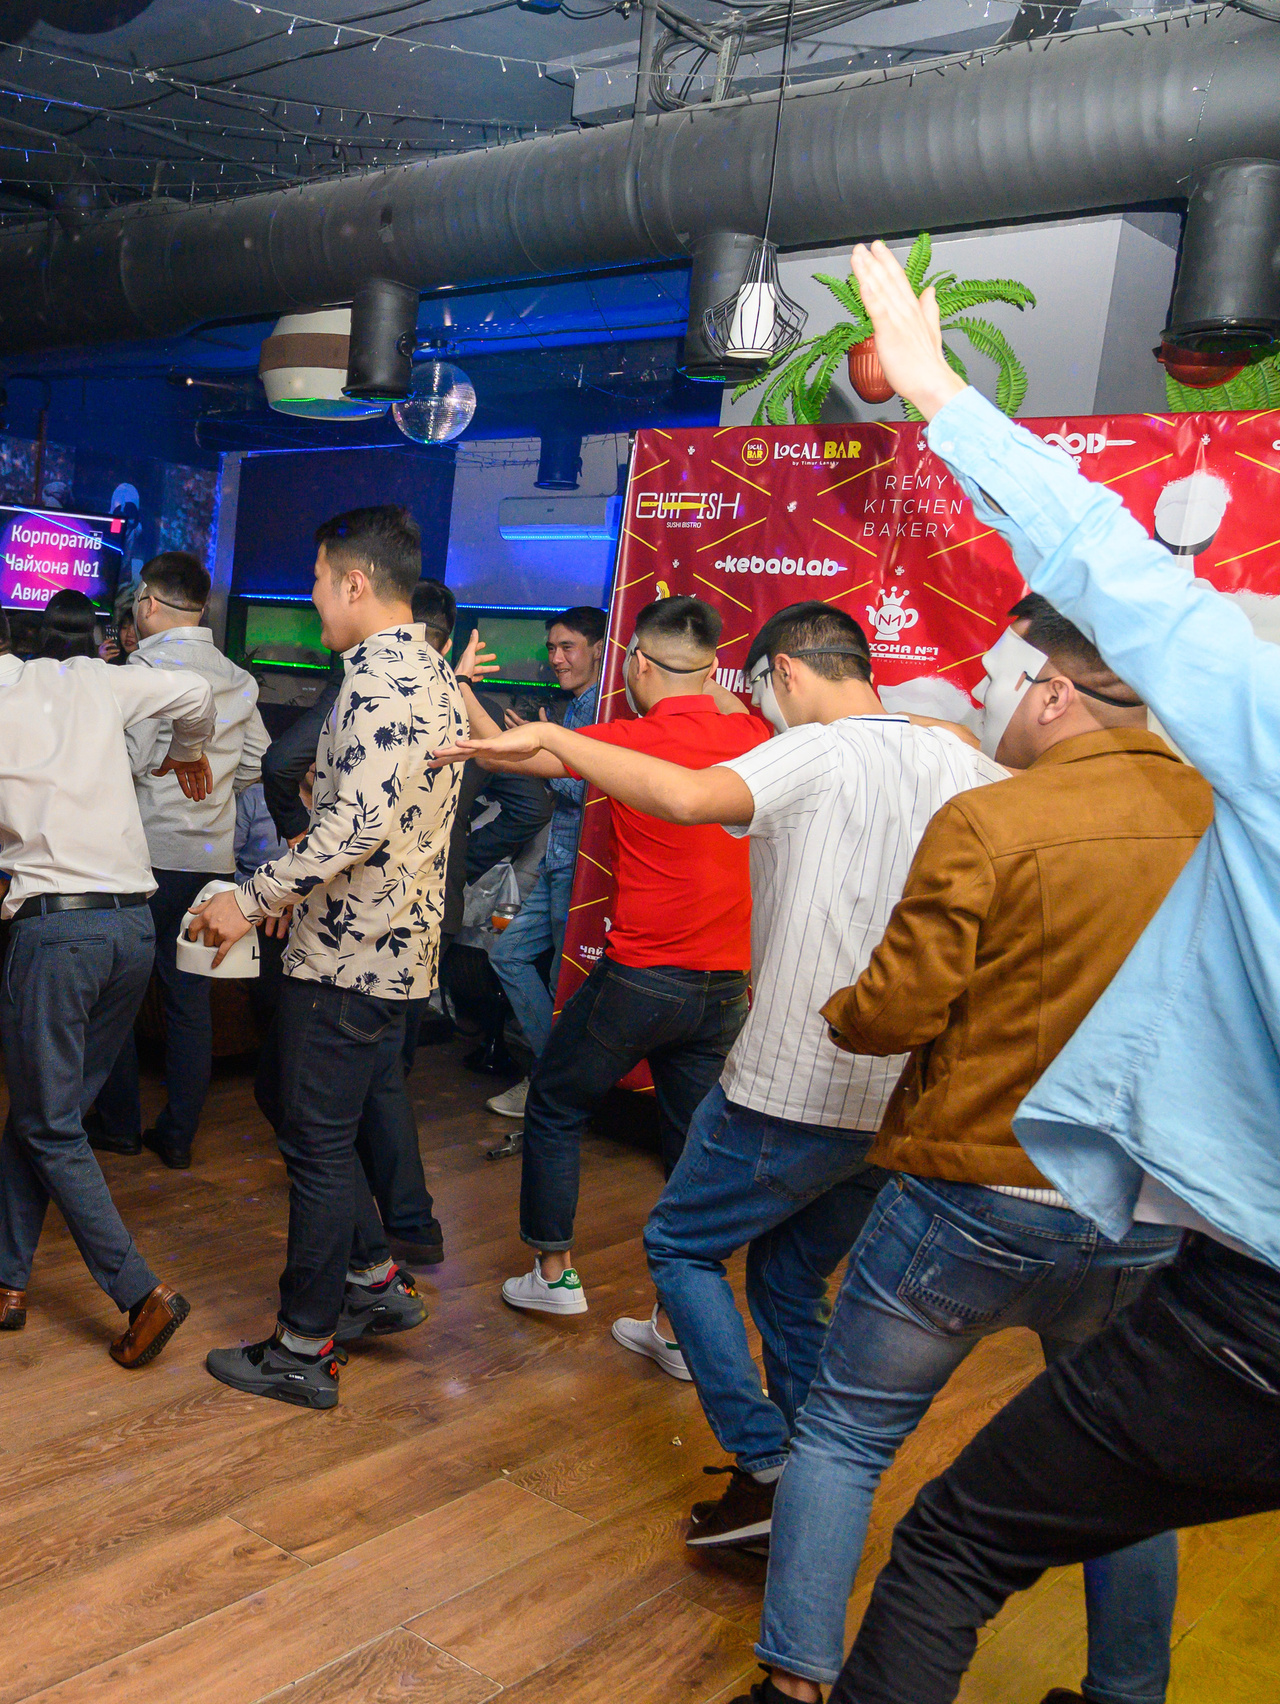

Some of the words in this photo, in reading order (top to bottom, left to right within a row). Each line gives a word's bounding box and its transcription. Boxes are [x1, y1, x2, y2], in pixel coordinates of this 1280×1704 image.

[746, 450, 764, 459] BAR
[823, 440, 862, 459] BAR
[884, 475, 948, 490] REMY
[863, 499, 963, 515] KITCHEN
[681, 521, 702, 529] BISTRO
[863, 522, 955, 538] BAKERY
[11, 524, 102, 550] Корпоратив
[5, 553, 69, 575] Чайхона
[73, 559, 99, 578] №1
[868, 642, 911, 654] ХОНА
[914, 645, 939, 656] №1
